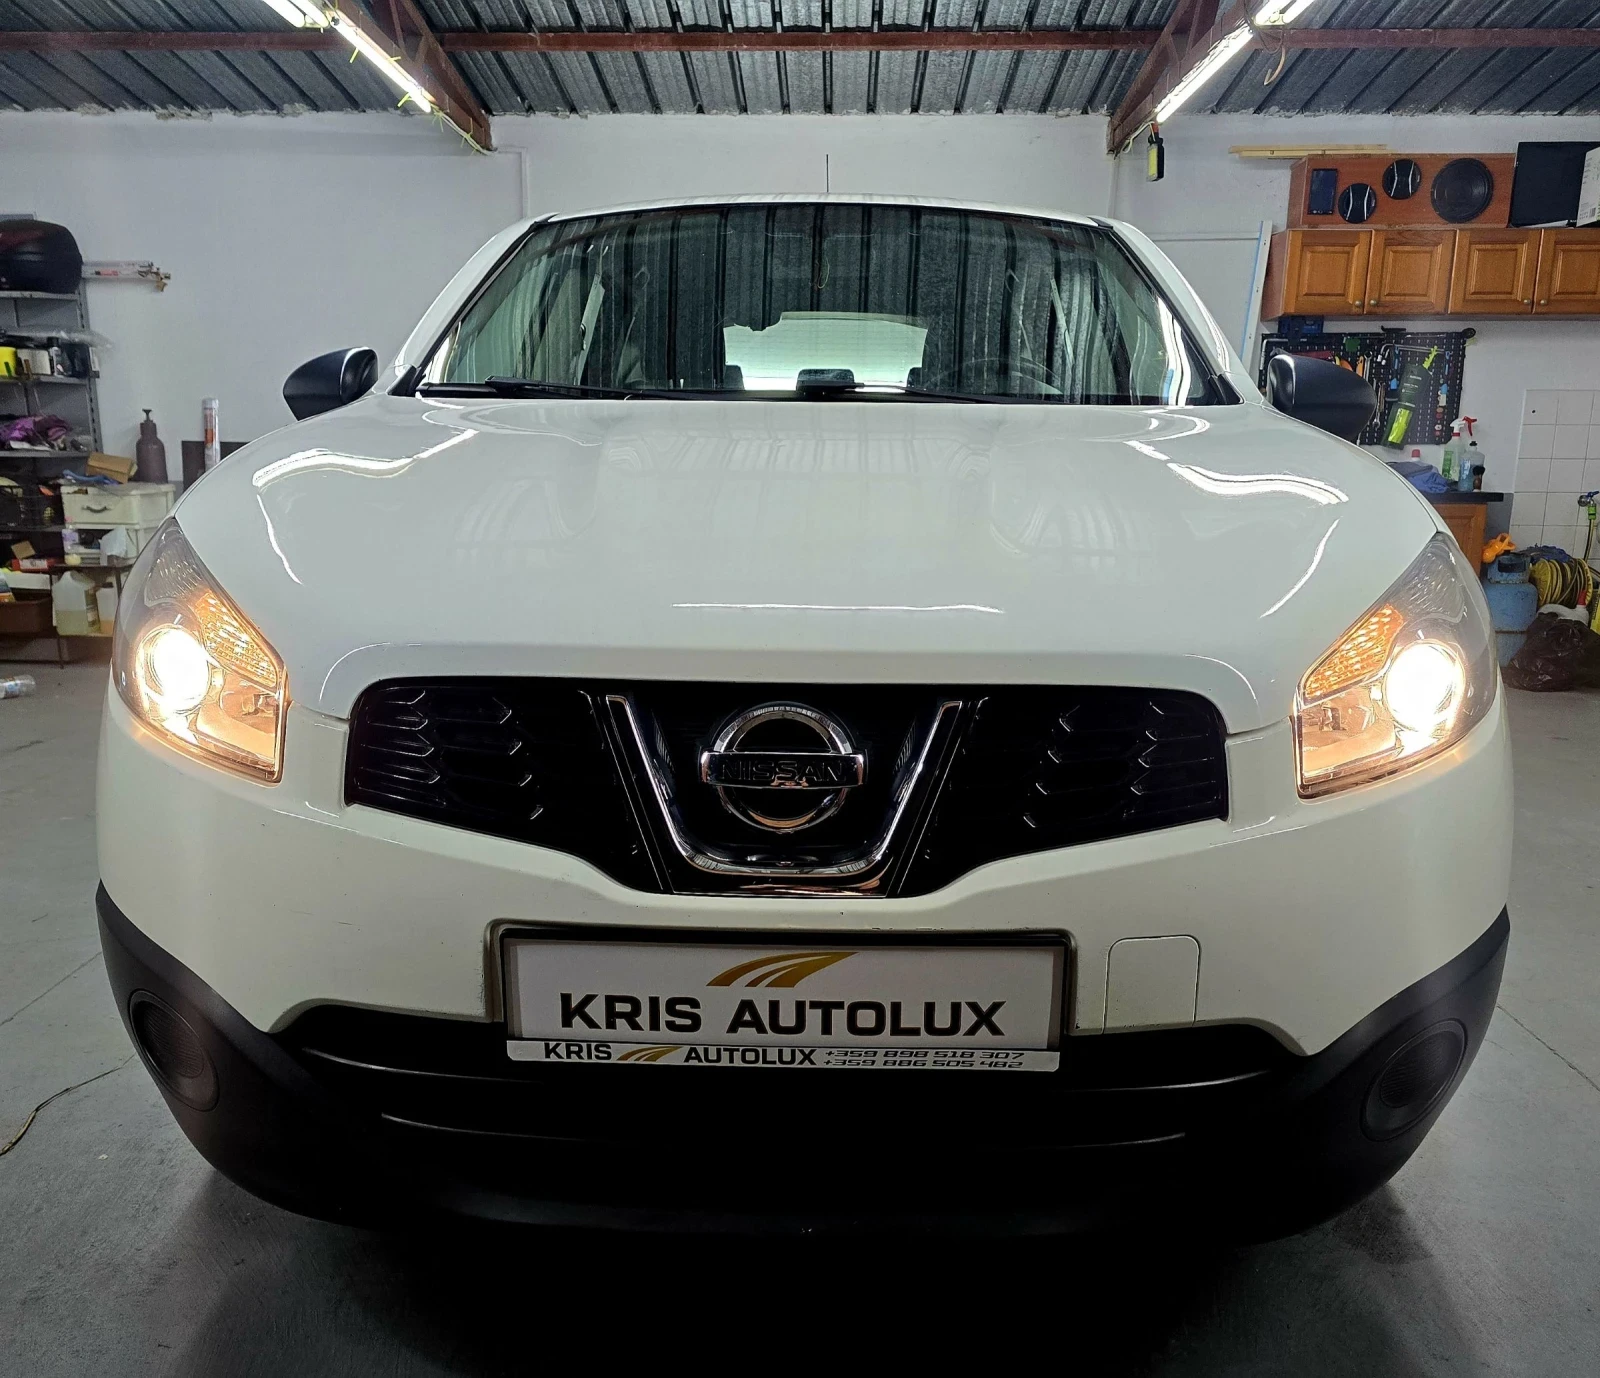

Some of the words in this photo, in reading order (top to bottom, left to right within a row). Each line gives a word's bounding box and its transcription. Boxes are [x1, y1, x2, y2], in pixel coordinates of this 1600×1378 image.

[721, 759, 846, 782] NISSAN
[560, 992, 701, 1033] KRIS
[726, 999, 1007, 1037] AUTOLUX
[544, 1041, 612, 1061] KRIS
[683, 1046, 817, 1066] AUTOLUX
[823, 1058, 876, 1067] +359
[882, 1059, 927, 1068] 886
[931, 1060, 974, 1068] 505
[979, 1060, 1023, 1069] 482
[825, 1050, 878, 1058] +359
[883, 1050, 929, 1059] 898
[933, 1051, 975, 1059] 518
[980, 1051, 1025, 1060] 307
